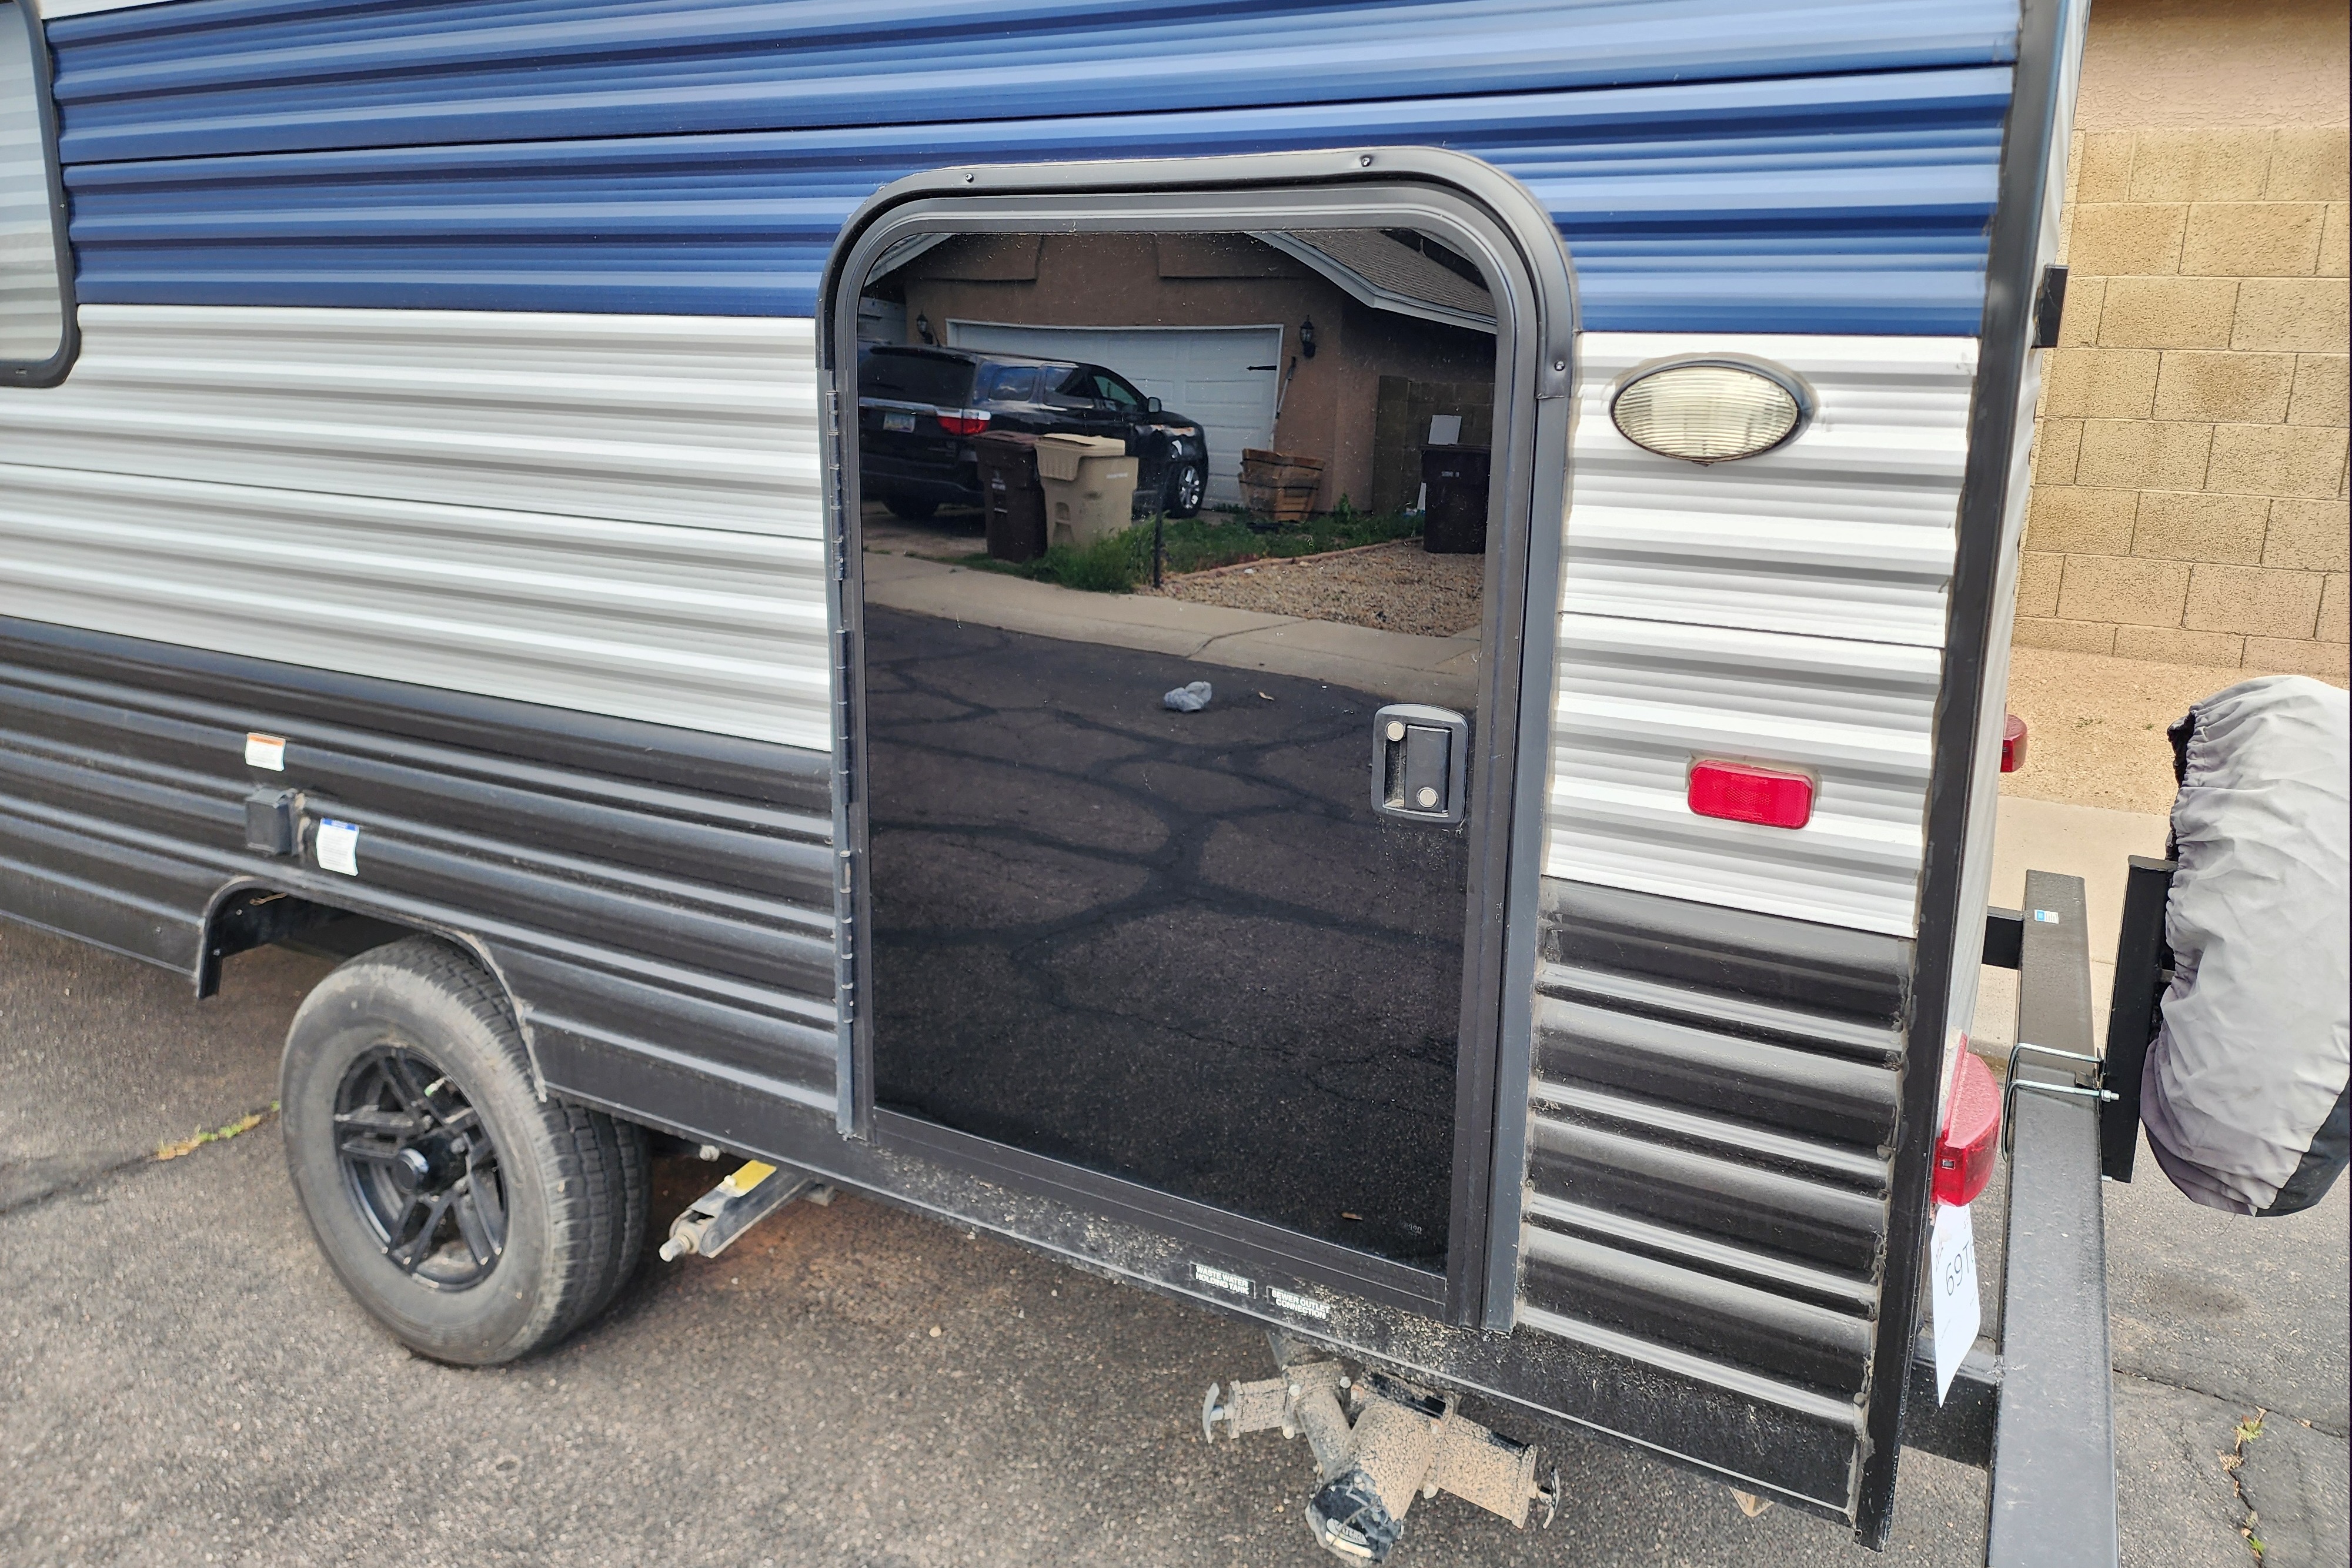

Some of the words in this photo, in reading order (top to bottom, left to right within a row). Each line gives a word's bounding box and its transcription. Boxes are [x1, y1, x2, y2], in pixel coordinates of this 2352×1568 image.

[1195, 1265, 1222, 1279] WASTE
[1222, 1273, 1248, 1288] WATER
[1195, 1271, 1229, 1289] HOLDING
[1229, 1282, 1250, 1295] TANK
[1271, 1289, 1299, 1305] SEWER
[1299, 1298, 1331, 1313] OUTLET
[1275, 1298, 1327, 1320] CONNECTION
